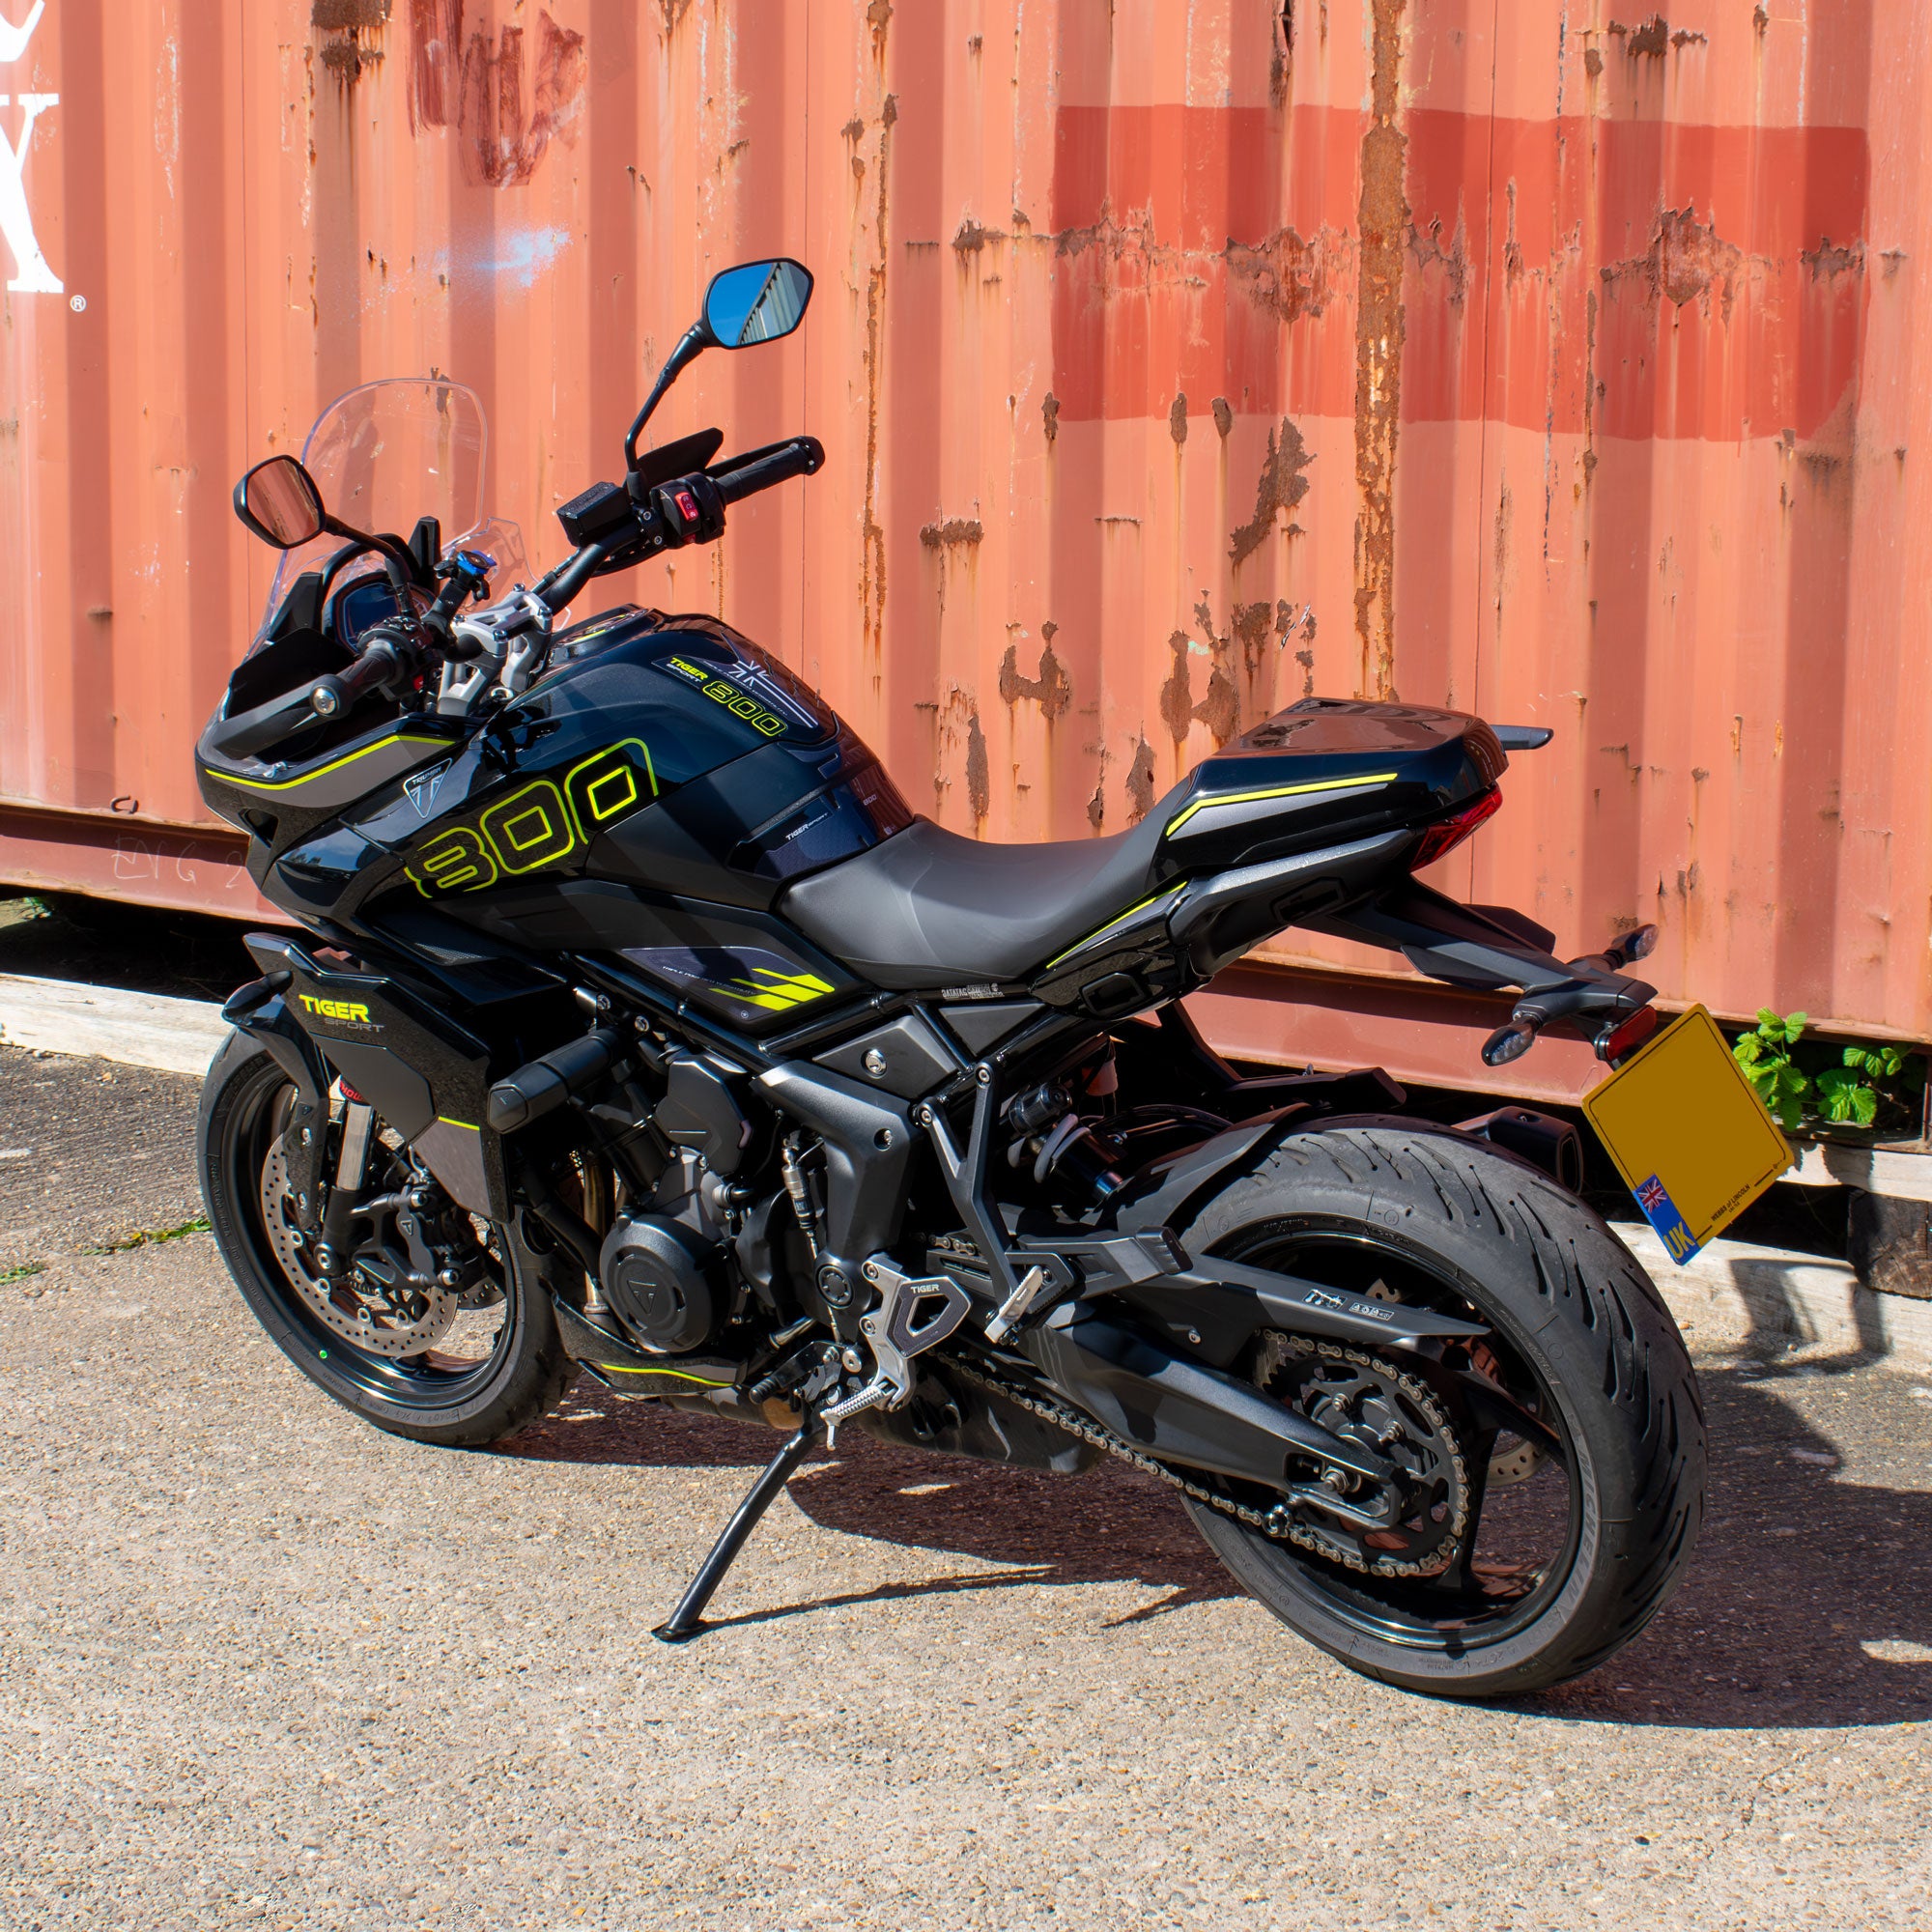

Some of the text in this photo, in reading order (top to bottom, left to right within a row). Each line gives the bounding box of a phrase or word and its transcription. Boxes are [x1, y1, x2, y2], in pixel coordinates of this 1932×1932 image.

[667, 663, 702, 682] SPORT
[670, 657, 708, 680] TIGER
[702, 680, 788, 737] 800
[785, 822, 810, 840] TIGER
[298, 993, 372, 1024] TIGER
[324, 1017, 384, 1033] SPORT
[1662, 1220, 1696, 1259] UK
[910, 1283, 941, 1294] TIGER
